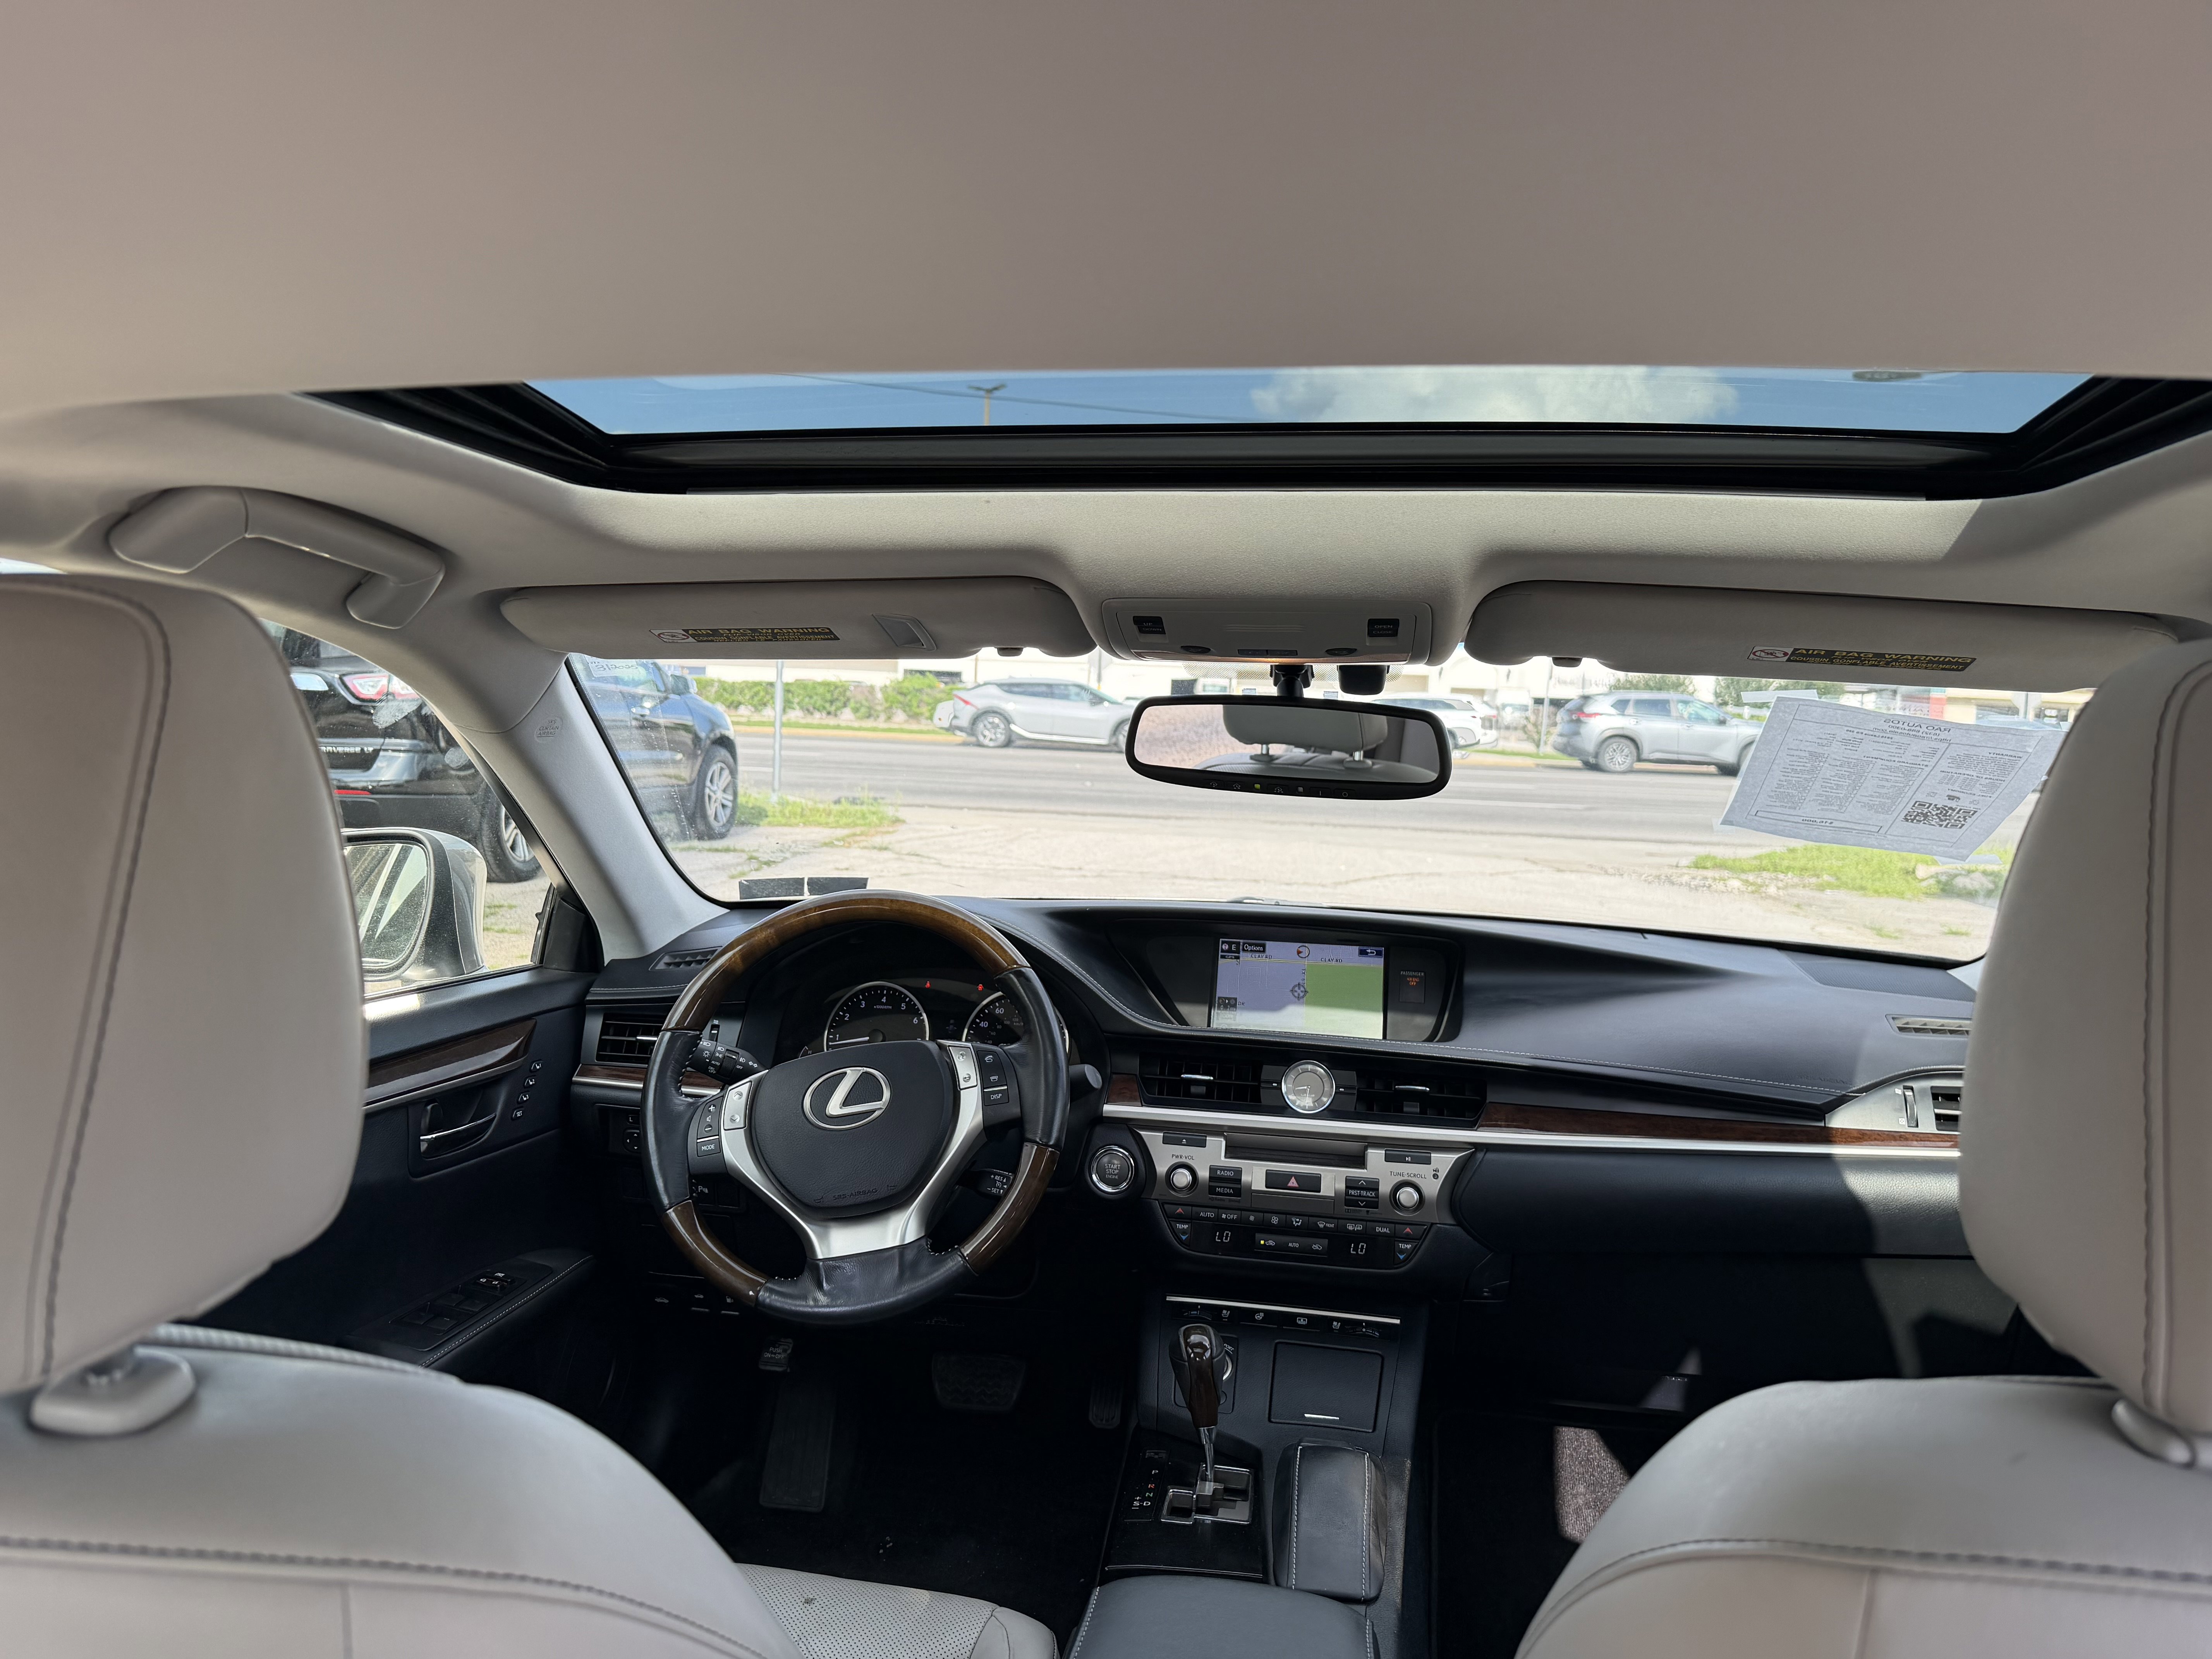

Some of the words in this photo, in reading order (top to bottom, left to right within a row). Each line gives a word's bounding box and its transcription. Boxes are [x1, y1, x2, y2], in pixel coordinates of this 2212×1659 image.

[1885, 654, 1973, 663] WARNING
[1215, 1231, 1231, 1242] LO
[1350, 1243, 1367, 1255] LO
